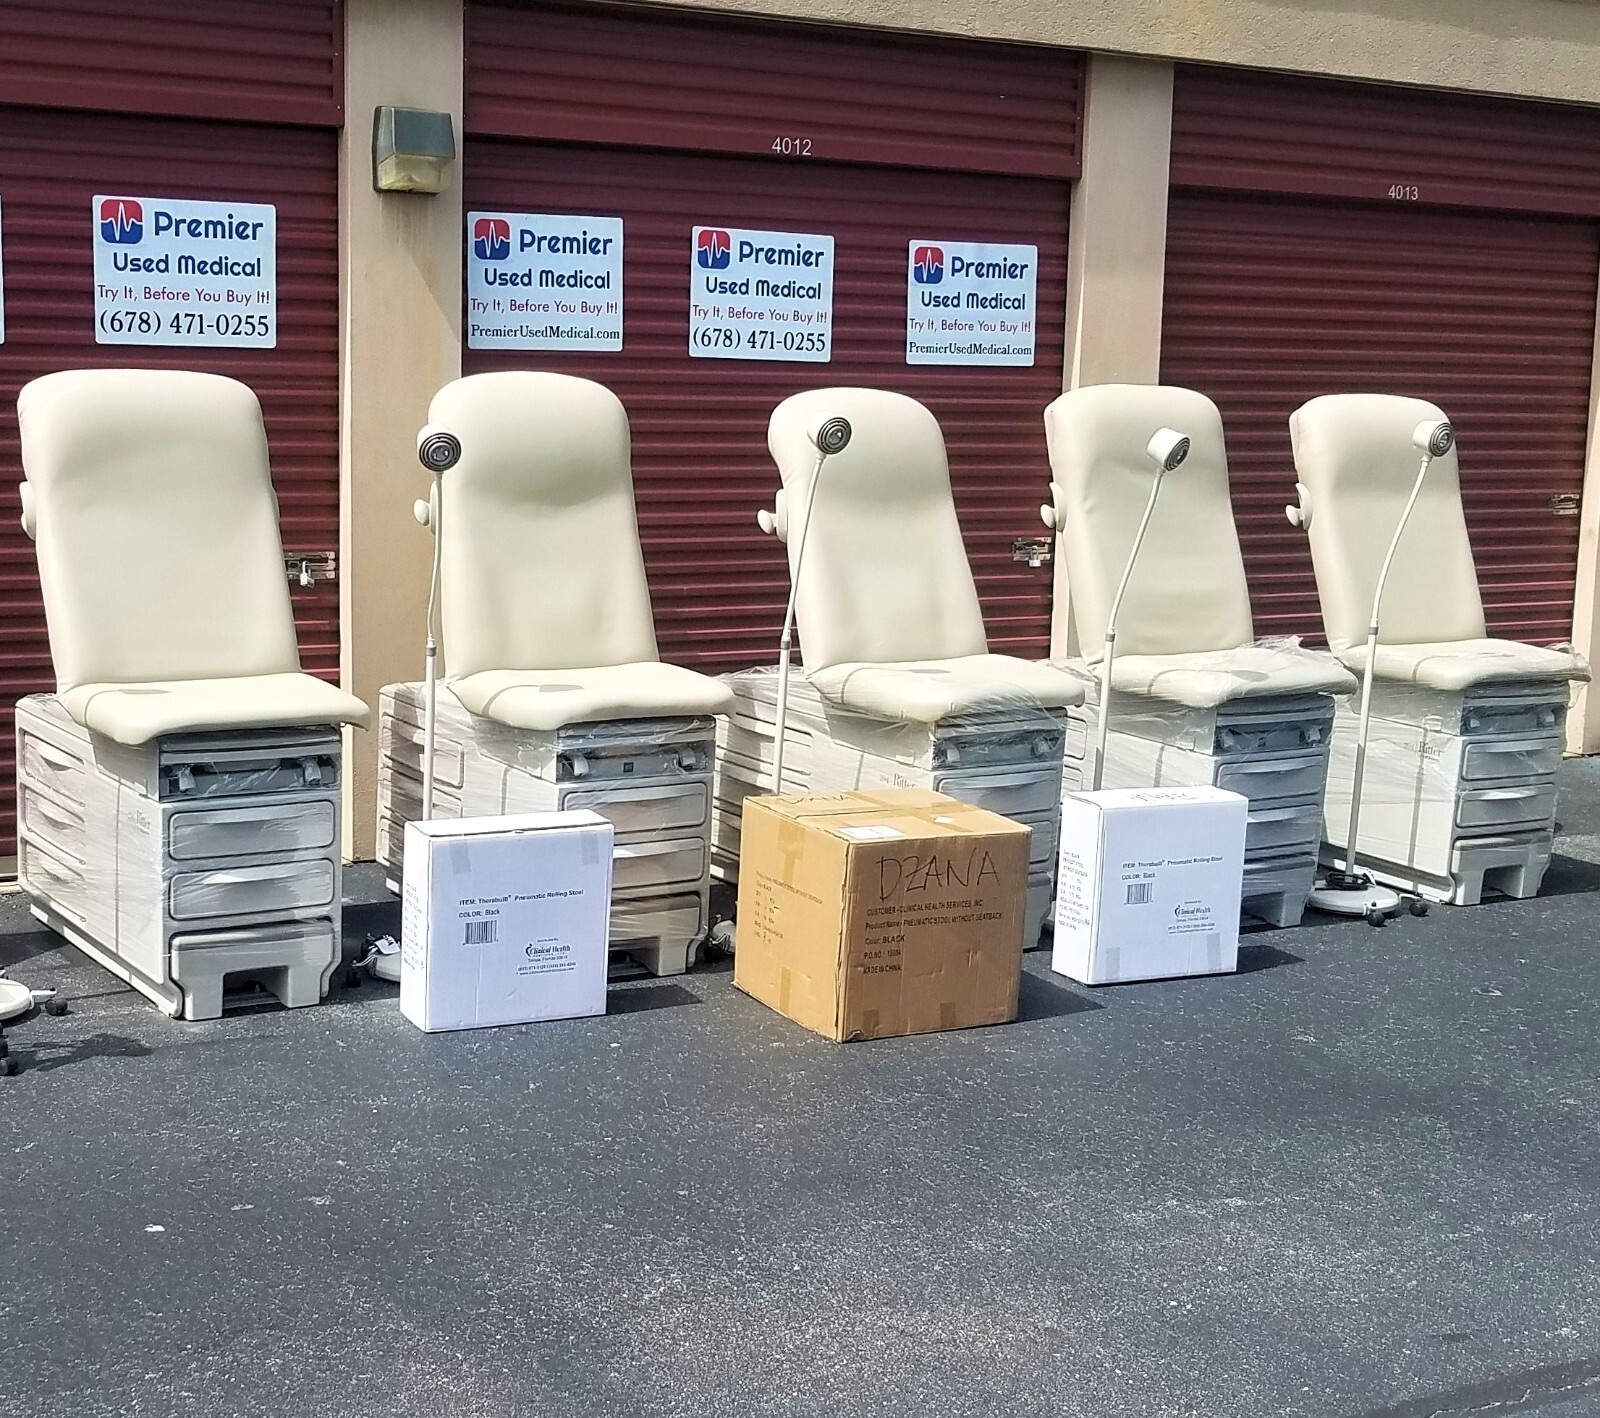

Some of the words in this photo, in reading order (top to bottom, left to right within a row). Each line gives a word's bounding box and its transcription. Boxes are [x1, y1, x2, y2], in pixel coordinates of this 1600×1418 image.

[771, 136, 812, 156] 4012
[1388, 184, 1418, 200] 4013
[154, 211, 263, 240] Premier
[520, 229, 613, 255] Premier
[739, 240, 824, 268] Premier
[113, 252, 169, 273] Used
[178, 255, 261, 277] Medical
[951, 256, 1029, 280] Premier
[484, 268, 532, 286] Used
[539, 269, 610, 289] Medical
[706, 276, 749, 295] Used
[756, 279, 822, 300] Medical
[97, 284, 118, 302] Try
[124, 286, 138, 301] It,
[143, 286, 190, 300] Before
[195, 288, 221, 302] You
[227, 289, 251, 306] Buy
[257, 291, 270, 304] It!
[921, 291, 960, 308] Used
[966, 292, 1026, 310] Medical
[470, 298, 489, 314] Try
[493, 299, 505, 314] It,
[510, 299, 549, 312] Before
[554, 300, 576, 313] You
[581, 301, 603, 317] Buy
[606, 301, 618, 314] It!
[693, 304, 709, 320] Try
[713, 305, 724, 320] It,
[728, 306, 765, 320] Before
[769, 308, 789, 321] You
[793, 310, 813, 325] Buy
[817, 311, 827, 324] It!
[100, 309, 162, 335] (678)
[169, 313, 269, 337] 471-0255
[471, 324, 620, 340] PremierUsedMedical.com
[909, 318, 924, 333] Try
[928, 319, 938, 333] It,
[941, 319, 974, 331] Before
[978, 320, 996, 332] You
[1000, 320, 1018, 335] Buy
[1021, 321, 1031, 333] It!
[693, 326, 741, 350] (678)
[747, 329, 826, 352] 471-0255
[909, 341, 1032, 355] PremierUsedMedical.com
[875, 847, 1000, 902] DZANA
[514, 893, 546, 902] Pneumatic
[547, 890, 568, 899] Rolling
[458, 910, 482, 919] COLOR:
[485, 908, 500, 916] Black
[924, 902, 945, 911] HEALTH
[882, 934, 905, 944] BLACK
[863, 965, 878, 974] MADE
[885, 964, 902, 973] CHINA
